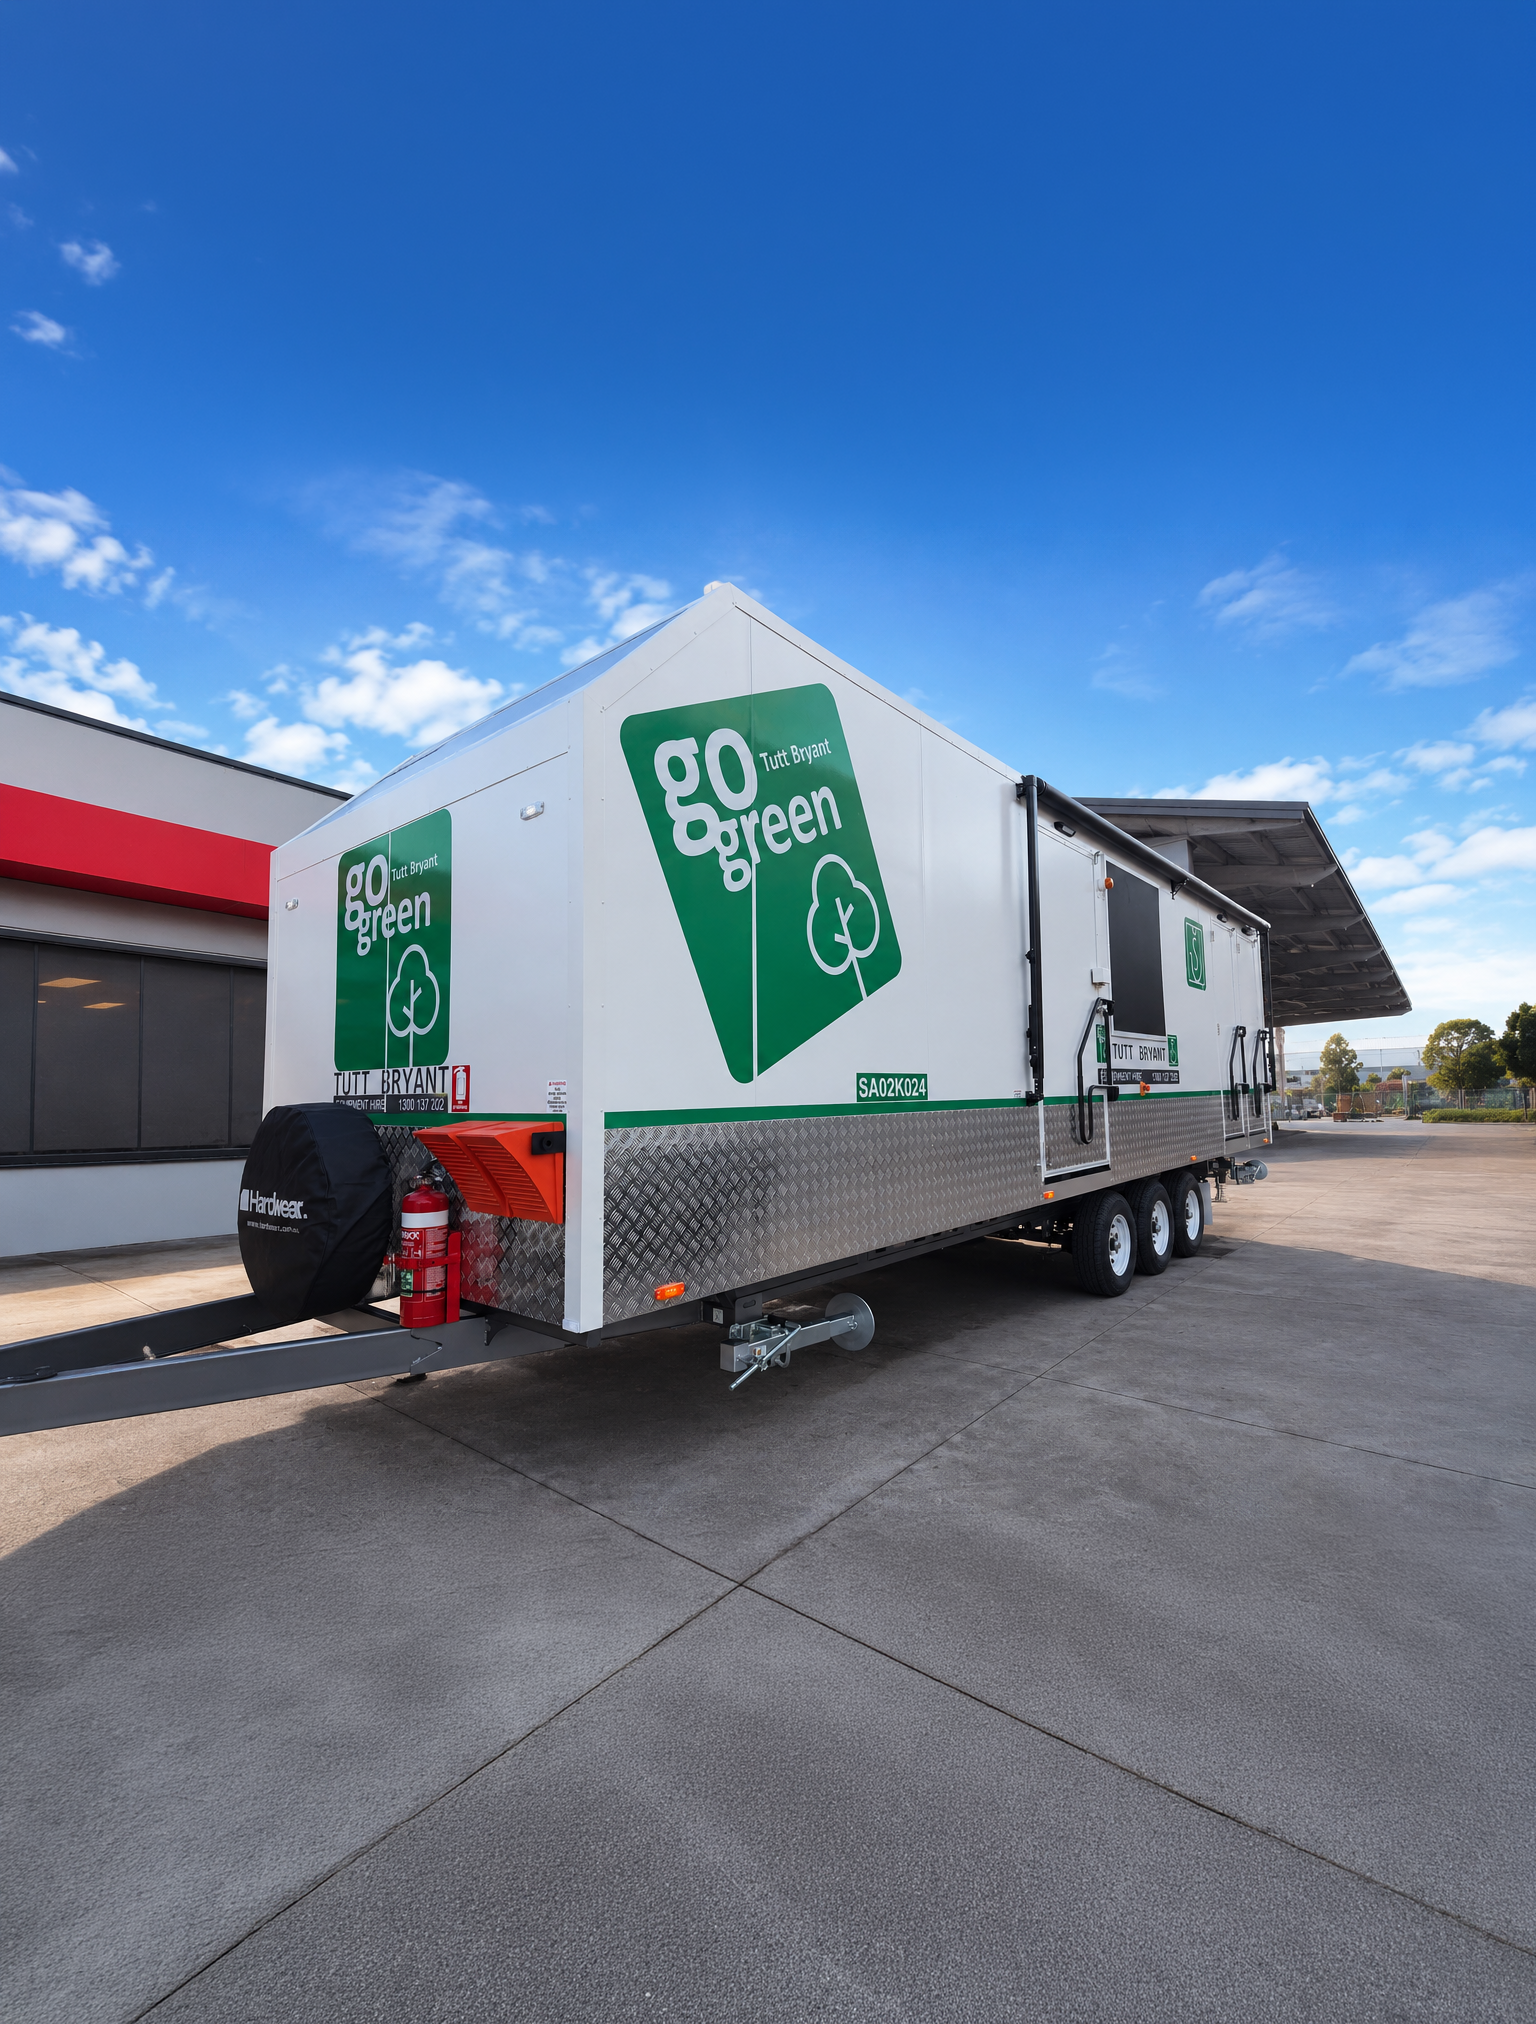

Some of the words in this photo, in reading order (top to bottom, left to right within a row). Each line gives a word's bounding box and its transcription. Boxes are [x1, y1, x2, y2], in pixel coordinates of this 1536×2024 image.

[759, 750, 790, 772] Tutt
[790, 738, 832, 765] Bryant
[654, 728, 758, 857] go
[715, 786, 842, 892] green
[391, 865, 408, 881] Tutt
[410, 853, 438, 875] Bryant
[344, 854, 389, 931] go
[357, 891, 431, 956] green
[1112, 1043, 1133, 1060] TUTT
[1139, 1045, 1166, 1061] BRYANT
[334, 1071, 370, 1096] TUTT
[381, 1066, 449, 1095] BRYANT
[859, 1077, 926, 1098] SA02K024
[399, 1098, 414, 1111] 1300
[417, 1098, 429, 1111] 137
